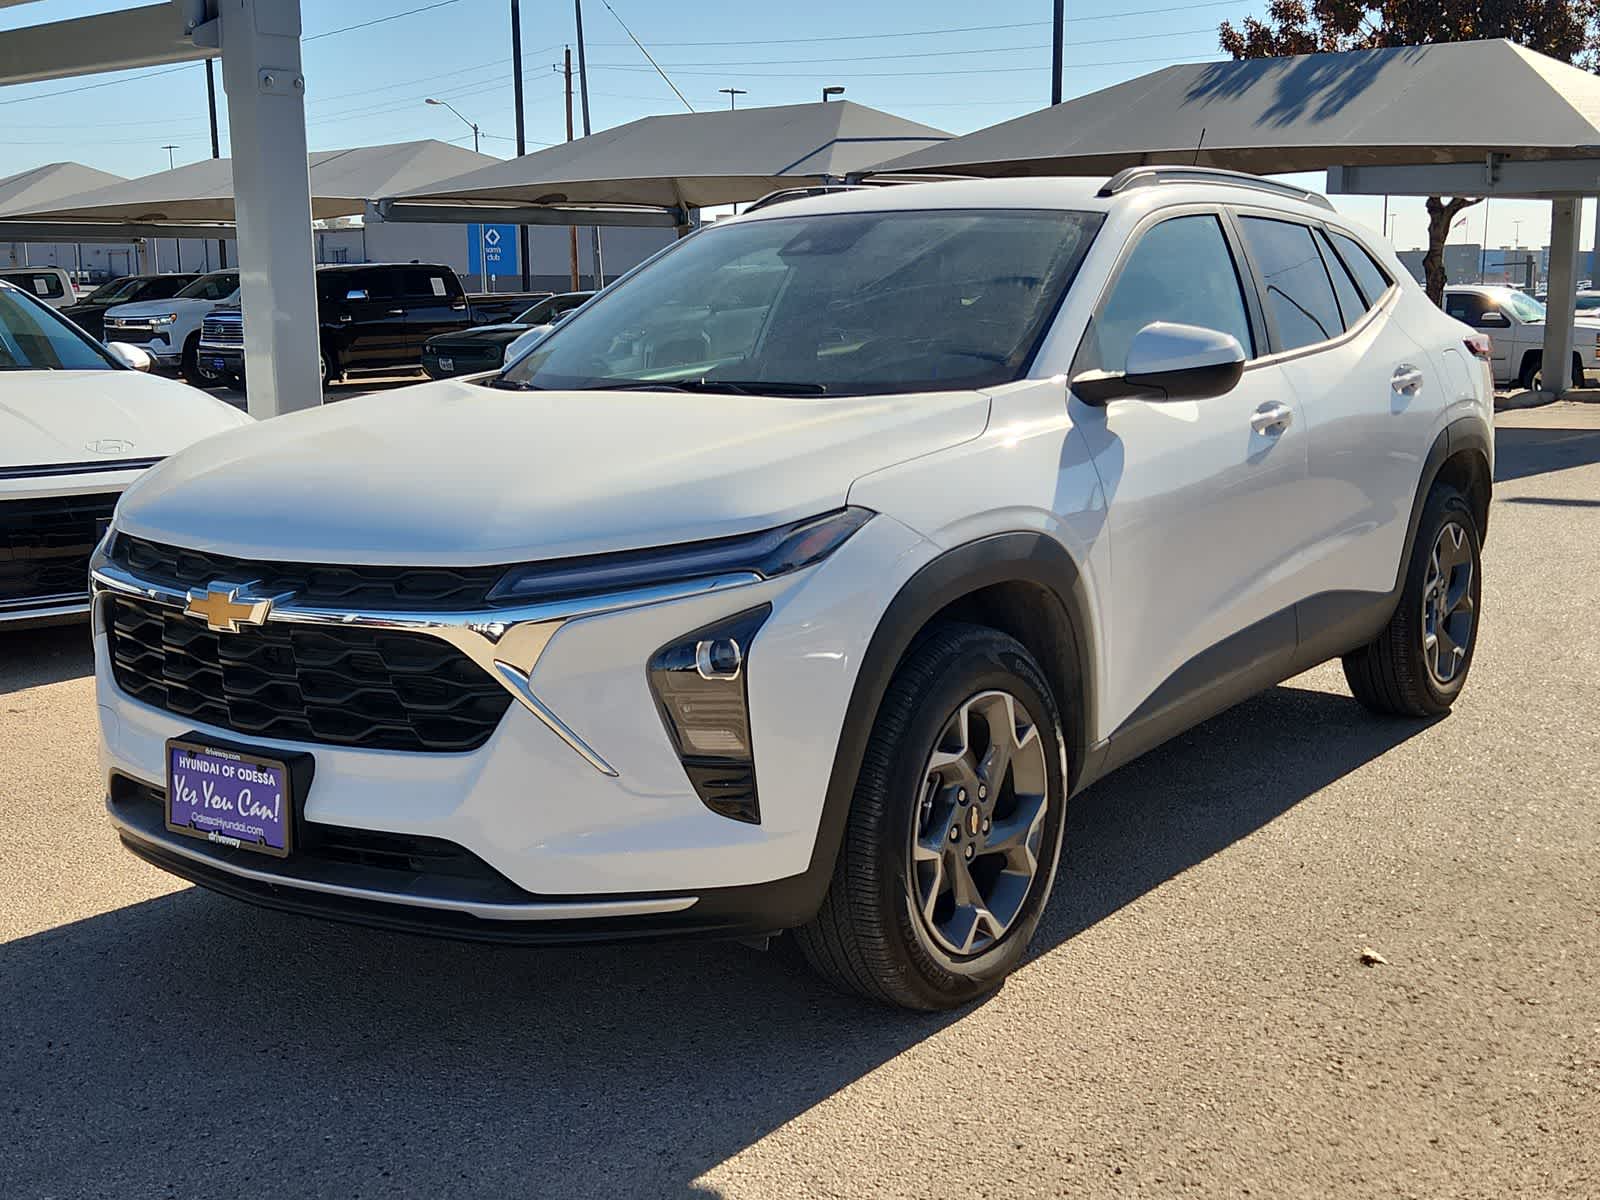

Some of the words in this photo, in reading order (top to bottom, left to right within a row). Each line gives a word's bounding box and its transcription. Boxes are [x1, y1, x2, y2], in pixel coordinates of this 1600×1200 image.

[205, 748, 241, 761] driveway.com
[179, 757, 219, 775] HYUNDAI
[222, 765, 235, 778] OF
[238, 769, 275, 787] ODESSA
[174, 775, 198, 805] Yes
[202, 781, 234, 811] You
[238, 789, 281, 823] Can!
[191, 812, 264, 836] OdessaHyundai.com
[208, 831, 241, 849] driveway
